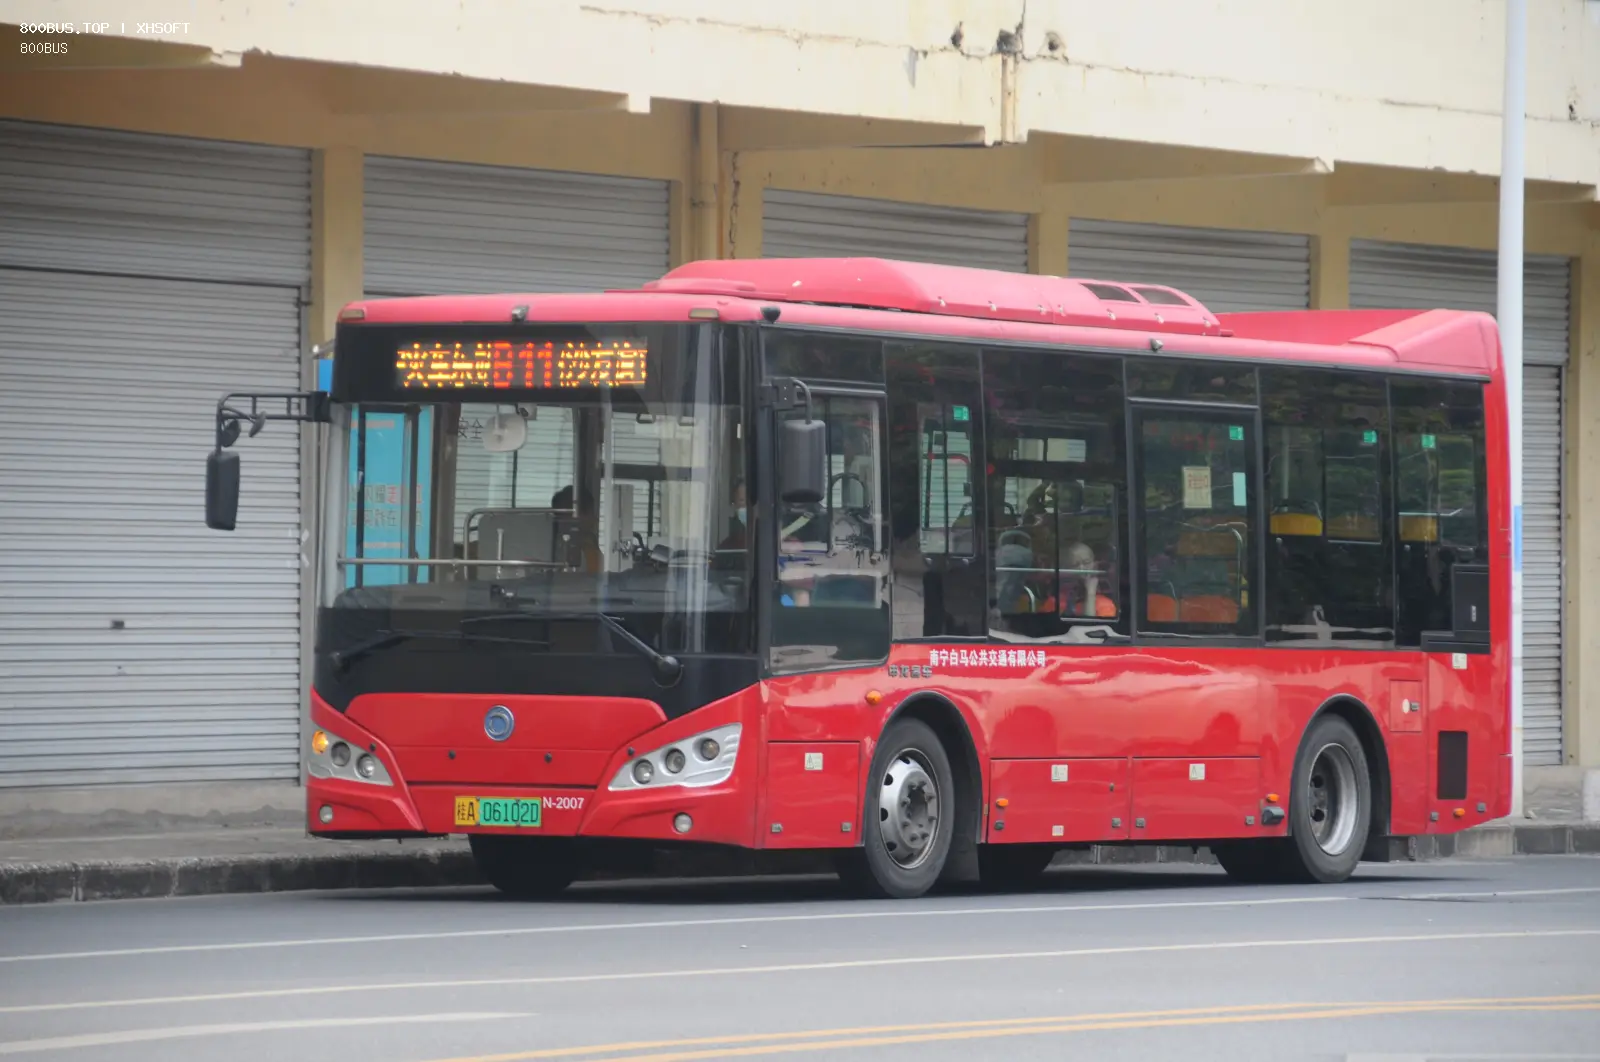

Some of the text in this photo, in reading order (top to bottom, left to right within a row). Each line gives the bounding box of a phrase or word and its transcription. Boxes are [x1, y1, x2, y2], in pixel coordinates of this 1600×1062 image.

[493, 340, 554, 388] B11
[929, 649, 1047, 668] 南宁白马公共交通有限公司
[456, 802, 476, 821] 桂A
[542, 797, 585, 809] N-2007
